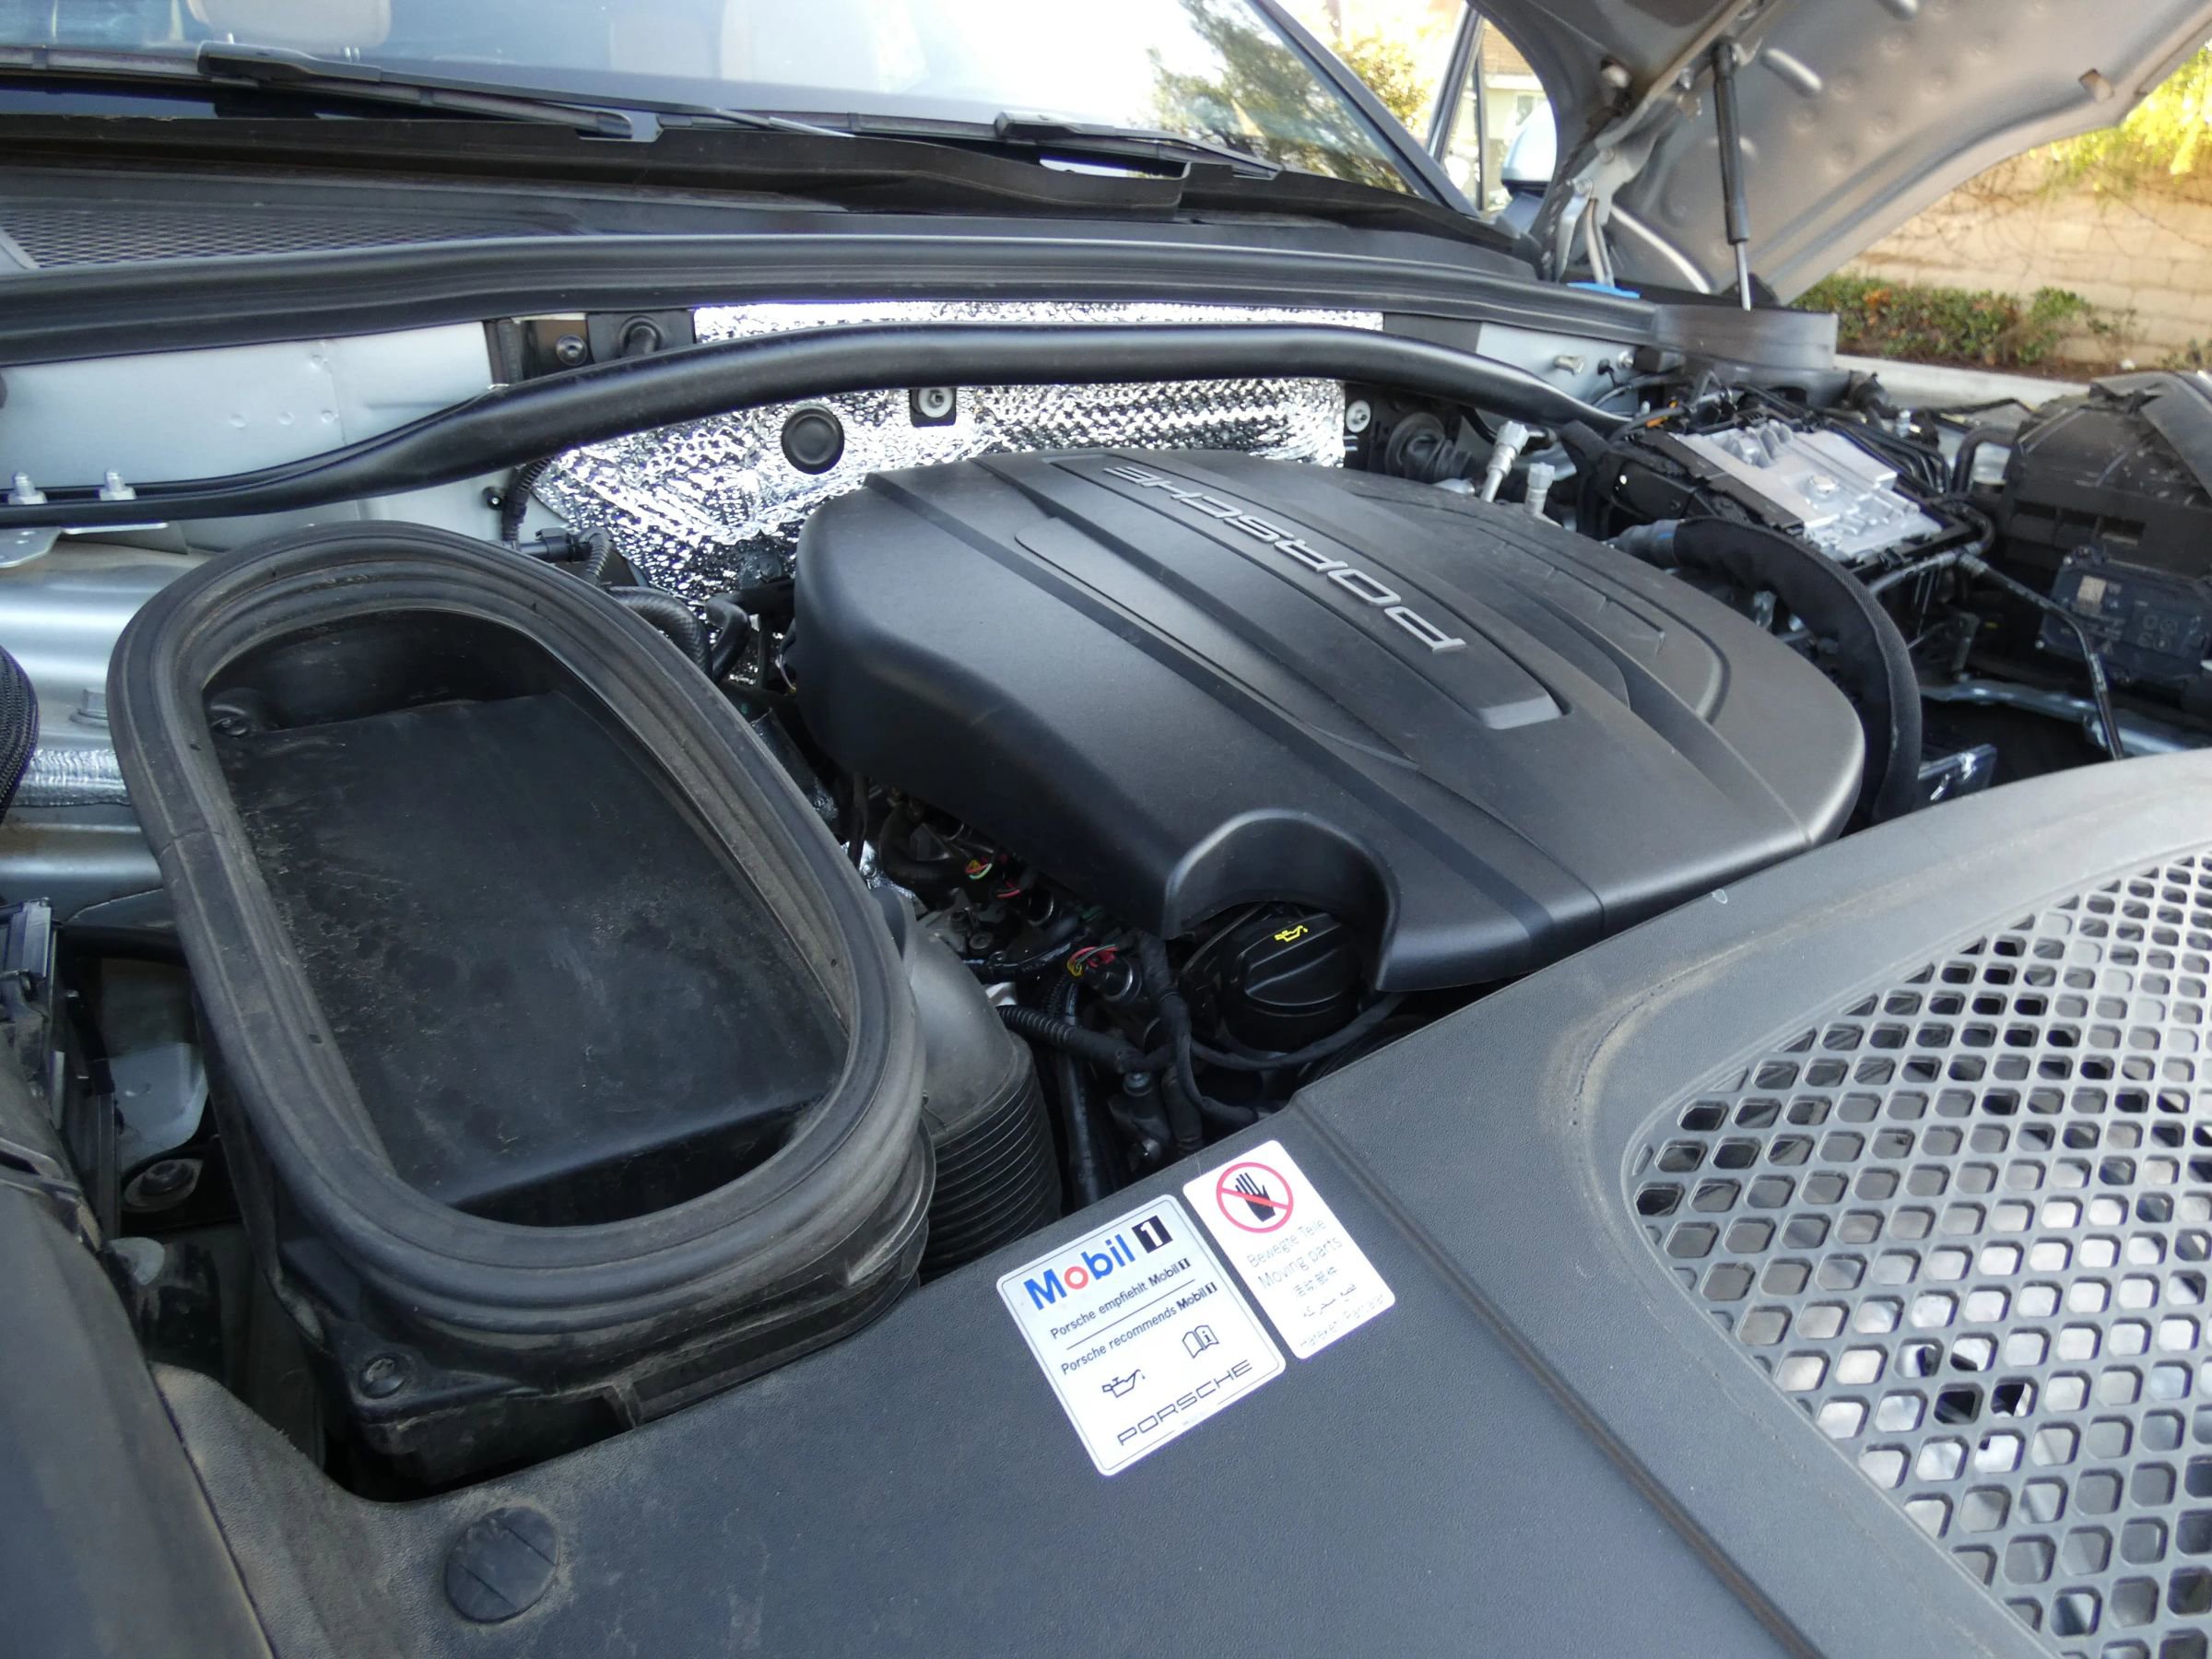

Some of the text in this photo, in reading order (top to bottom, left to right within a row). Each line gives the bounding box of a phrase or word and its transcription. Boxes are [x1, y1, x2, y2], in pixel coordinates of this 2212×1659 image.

[1103, 466, 1467, 653] PORSCHE
[1023, 1233, 1135, 1311] Mobil
[1257, 1255, 1310, 1288] Moving
[1308, 1236, 1343, 1264] parts
[1050, 1310, 1097, 1339] Porsche
[1098, 1282, 1148, 1316] empfiehlt
[1061, 1346, 1107, 1375] Porsche
[1108, 1306, 1178, 1349] recommends
[1116, 1359, 1253, 1446] PORSCHE
